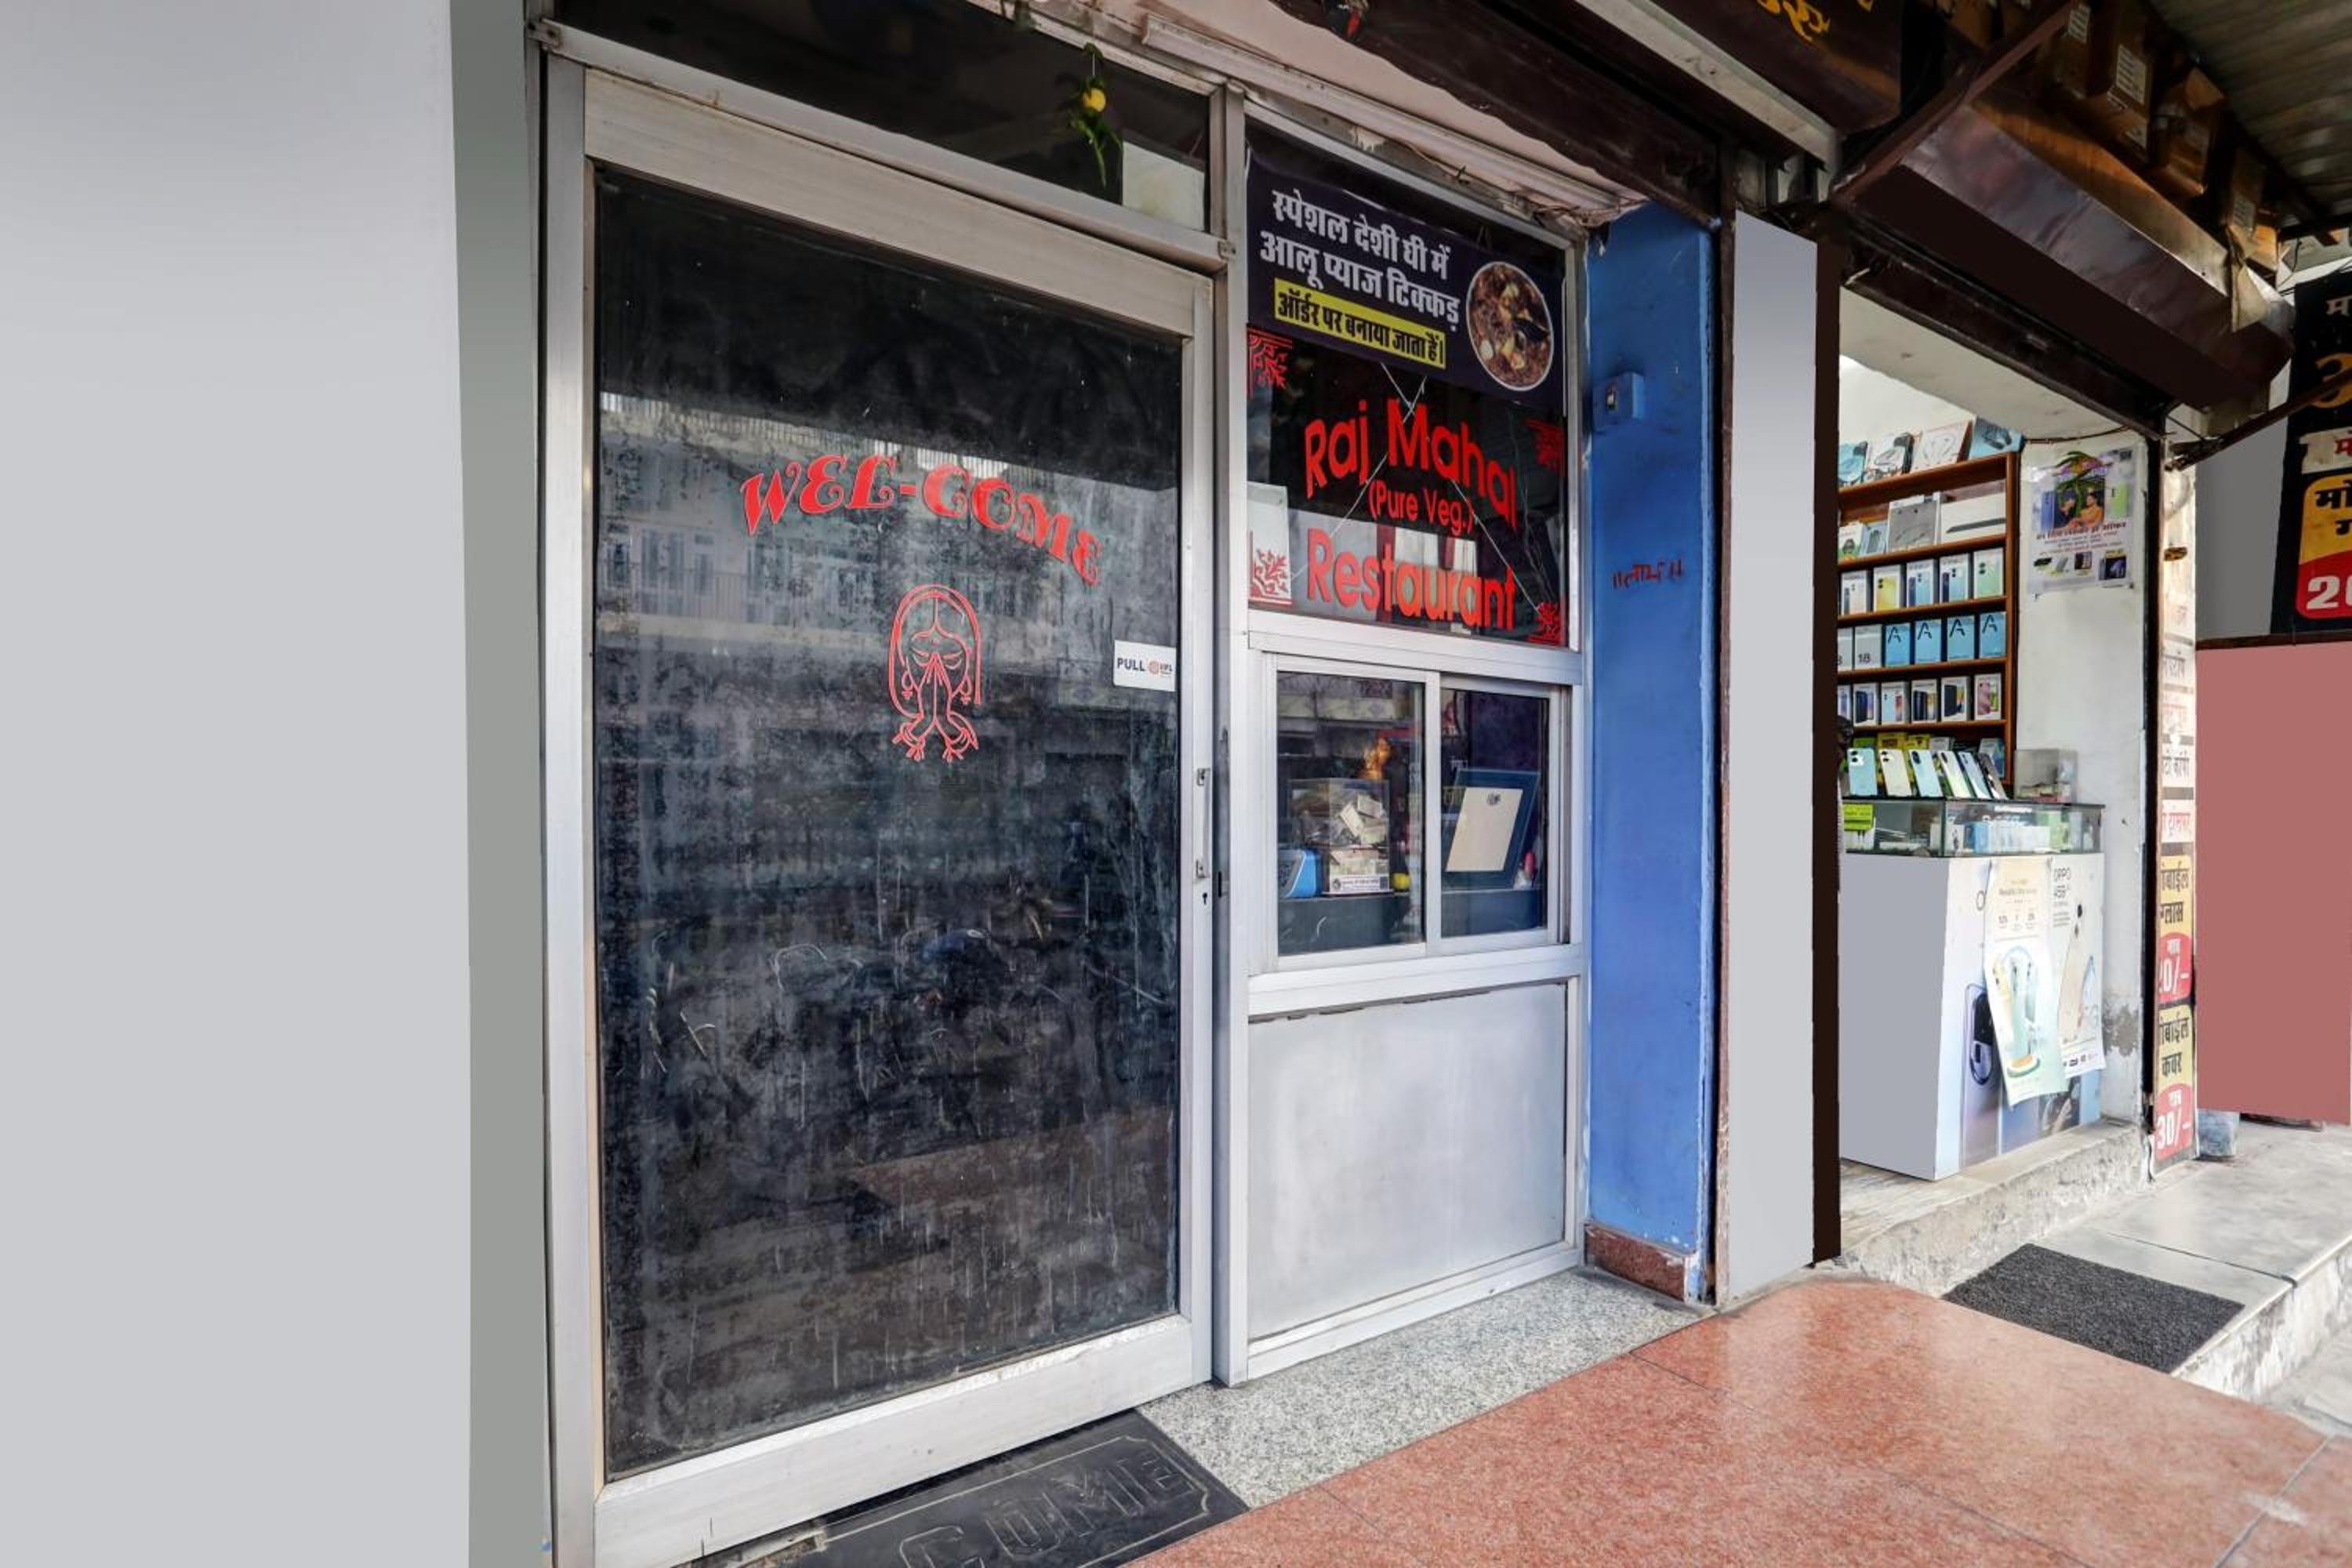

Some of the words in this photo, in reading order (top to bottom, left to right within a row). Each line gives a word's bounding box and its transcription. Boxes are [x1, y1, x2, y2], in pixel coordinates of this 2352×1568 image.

[1260, 230, 1323, 291] आलू
[1323, 253, 1384, 299] प्याज
[1387, 269, 1461, 332] टिक्कड़
[1272, 188, 1349, 245] स्पेशल
[1353, 214, 1399, 263] देशी
[1402, 235, 1427, 274] घी
[1432, 245, 1451, 280] में
[1278, 289, 1321, 330] ऑर्डर
[1323, 305, 1342, 333] पर
[1345, 314, 1391, 348] बनाया
[1392, 328, 1426, 359] जाता
[1304, 399, 1369, 499] Raj
[1386, 397, 1518, 529] Mahal
[1367, 478, 1420, 521] (Pure
[1424, 488, 1475, 538] Veg.)
[739, 453, 1104, 588] WEL-COME
[1306, 526, 1515, 629] Restaurant
[1116, 657, 1145, 673] PULL
